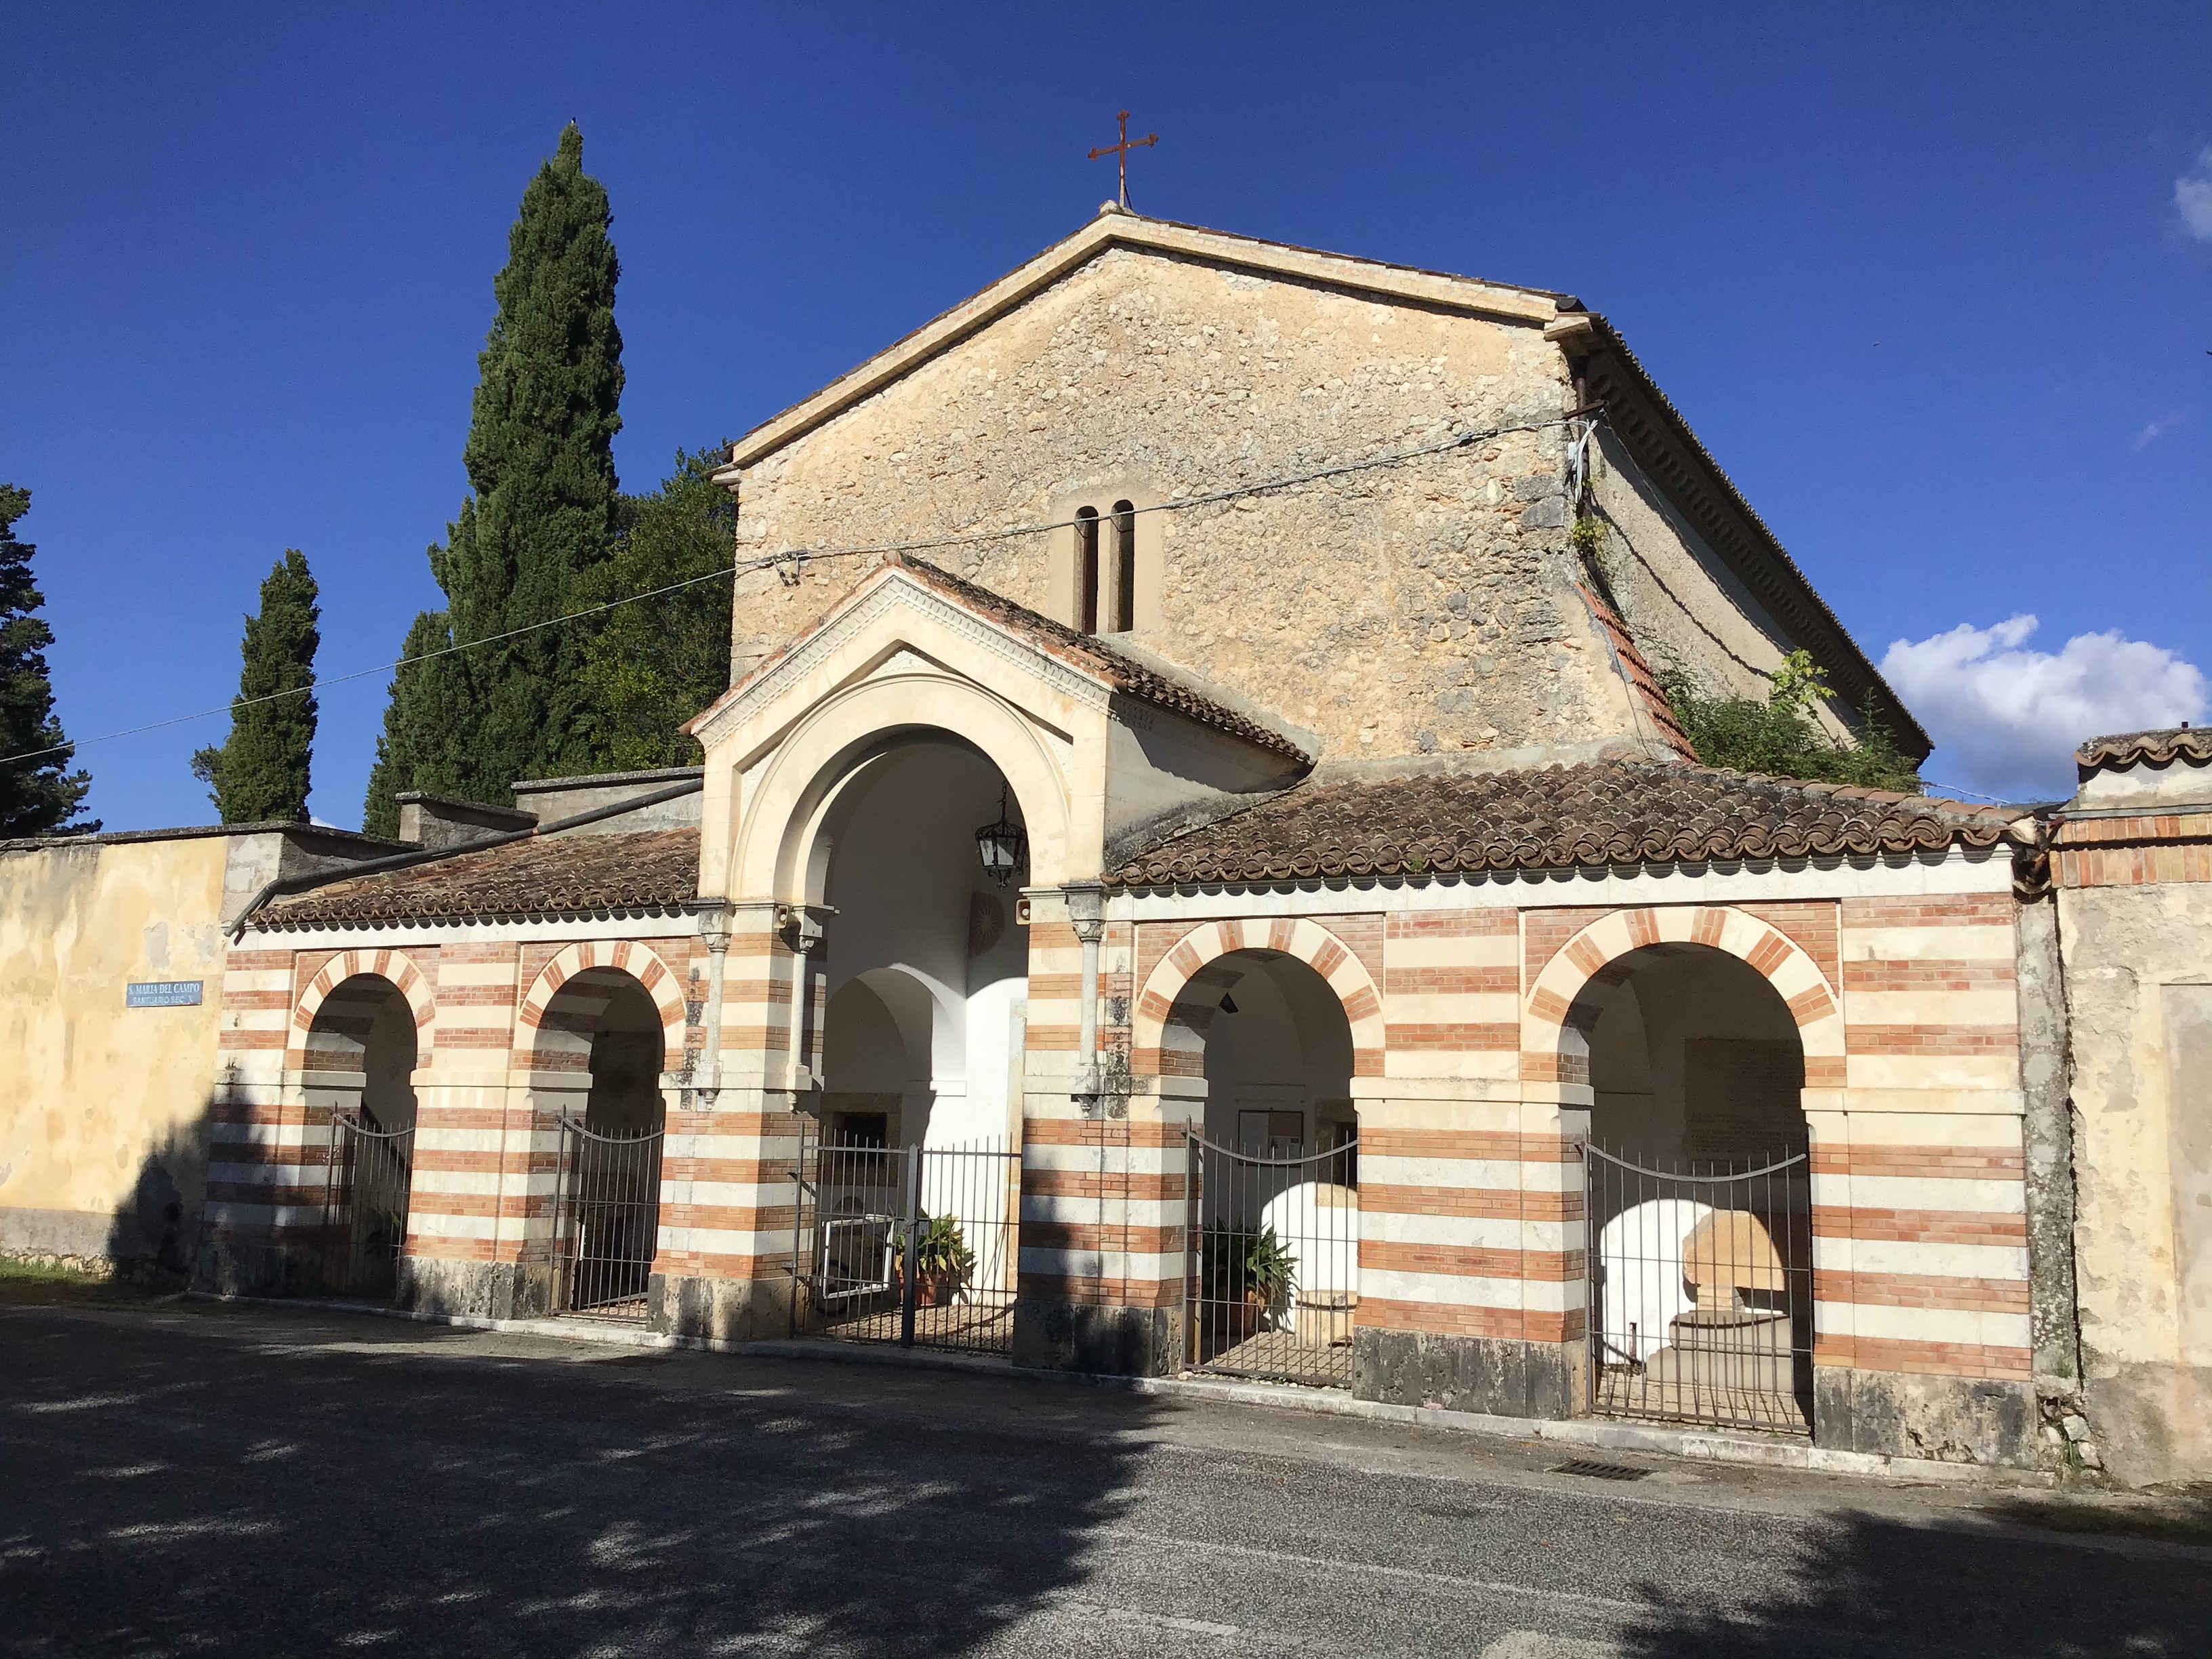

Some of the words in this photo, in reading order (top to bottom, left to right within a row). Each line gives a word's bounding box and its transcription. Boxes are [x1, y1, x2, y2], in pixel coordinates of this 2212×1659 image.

[136, 985, 158, 994] MARIA
[159, 984, 172, 994] DEL
[173, 983, 200, 993] CAMPO
[133, 996, 169, 1004] SANTUARIO
